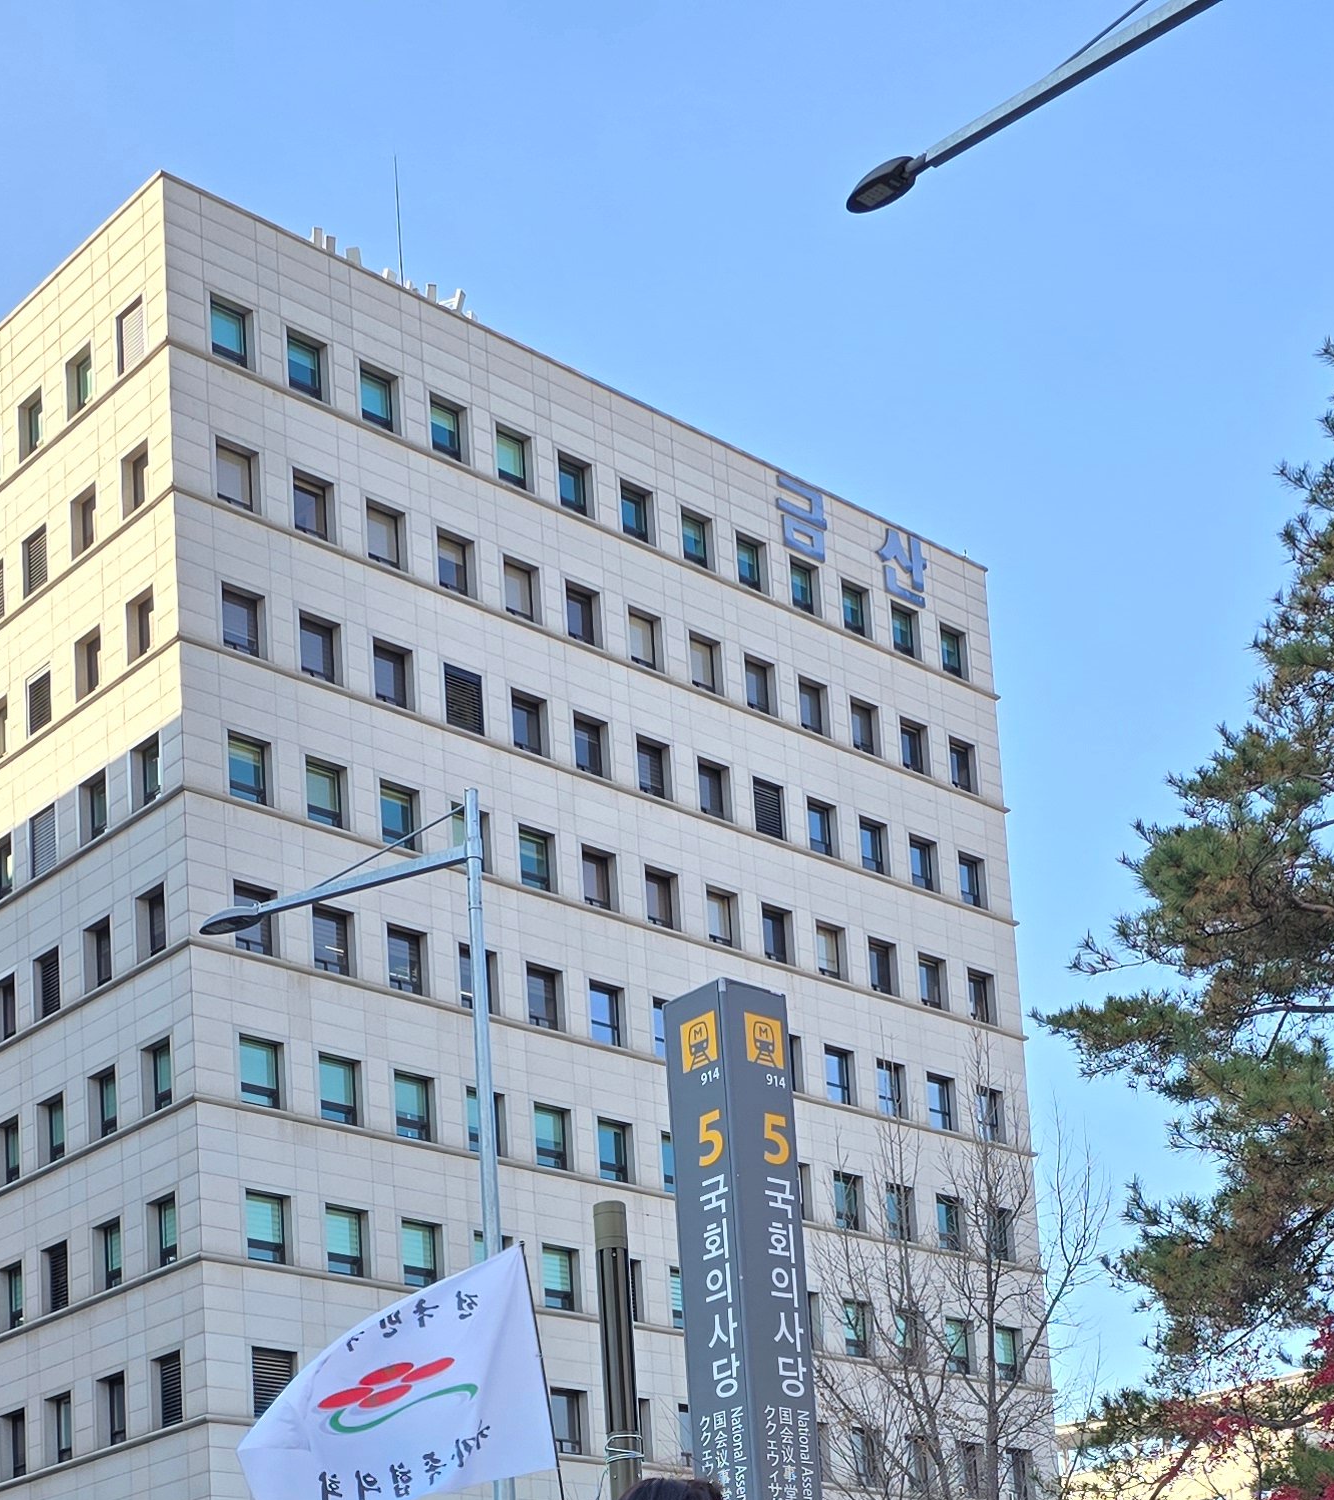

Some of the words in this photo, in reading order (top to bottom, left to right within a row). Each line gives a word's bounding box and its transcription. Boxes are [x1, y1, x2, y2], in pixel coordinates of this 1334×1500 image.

[775, 473, 927, 608] 금산
[701, 1067, 719, 1086] 914
[766, 1074, 786, 1088] 914
[699, 1109, 723, 1167] 5
[764, 1113, 790, 1165] 5
[700, 1174, 740, 1398] 국회의사당
[765, 1177, 807, 1397] 국회의사당
[731, 1406, 747, 1462] National
[797, 1410, 814, 1464] National
